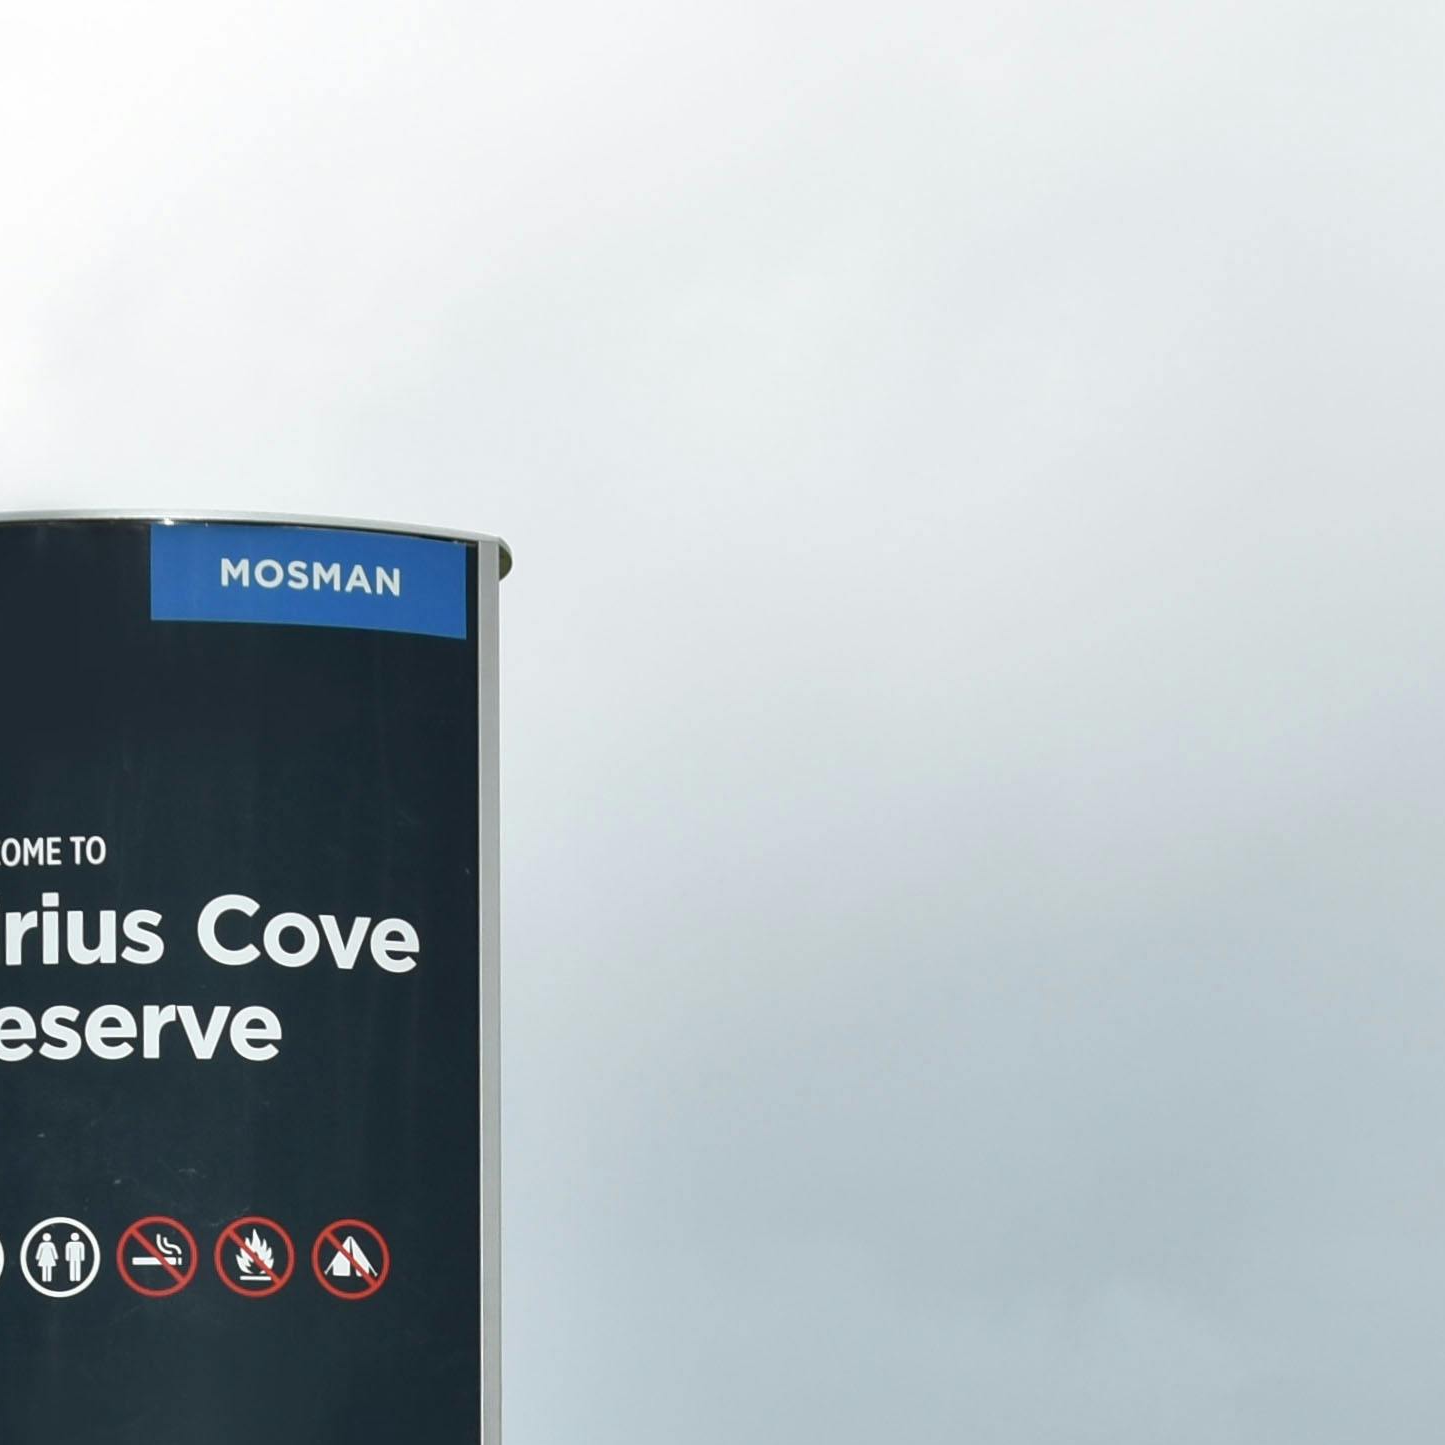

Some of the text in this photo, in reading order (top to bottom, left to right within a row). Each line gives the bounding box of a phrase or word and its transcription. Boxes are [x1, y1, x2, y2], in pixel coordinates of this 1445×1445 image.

[219, 556, 400, 597] MOSMAN
[70, 836, 106, 865] TO
[197, 894, 419, 973] Cove
